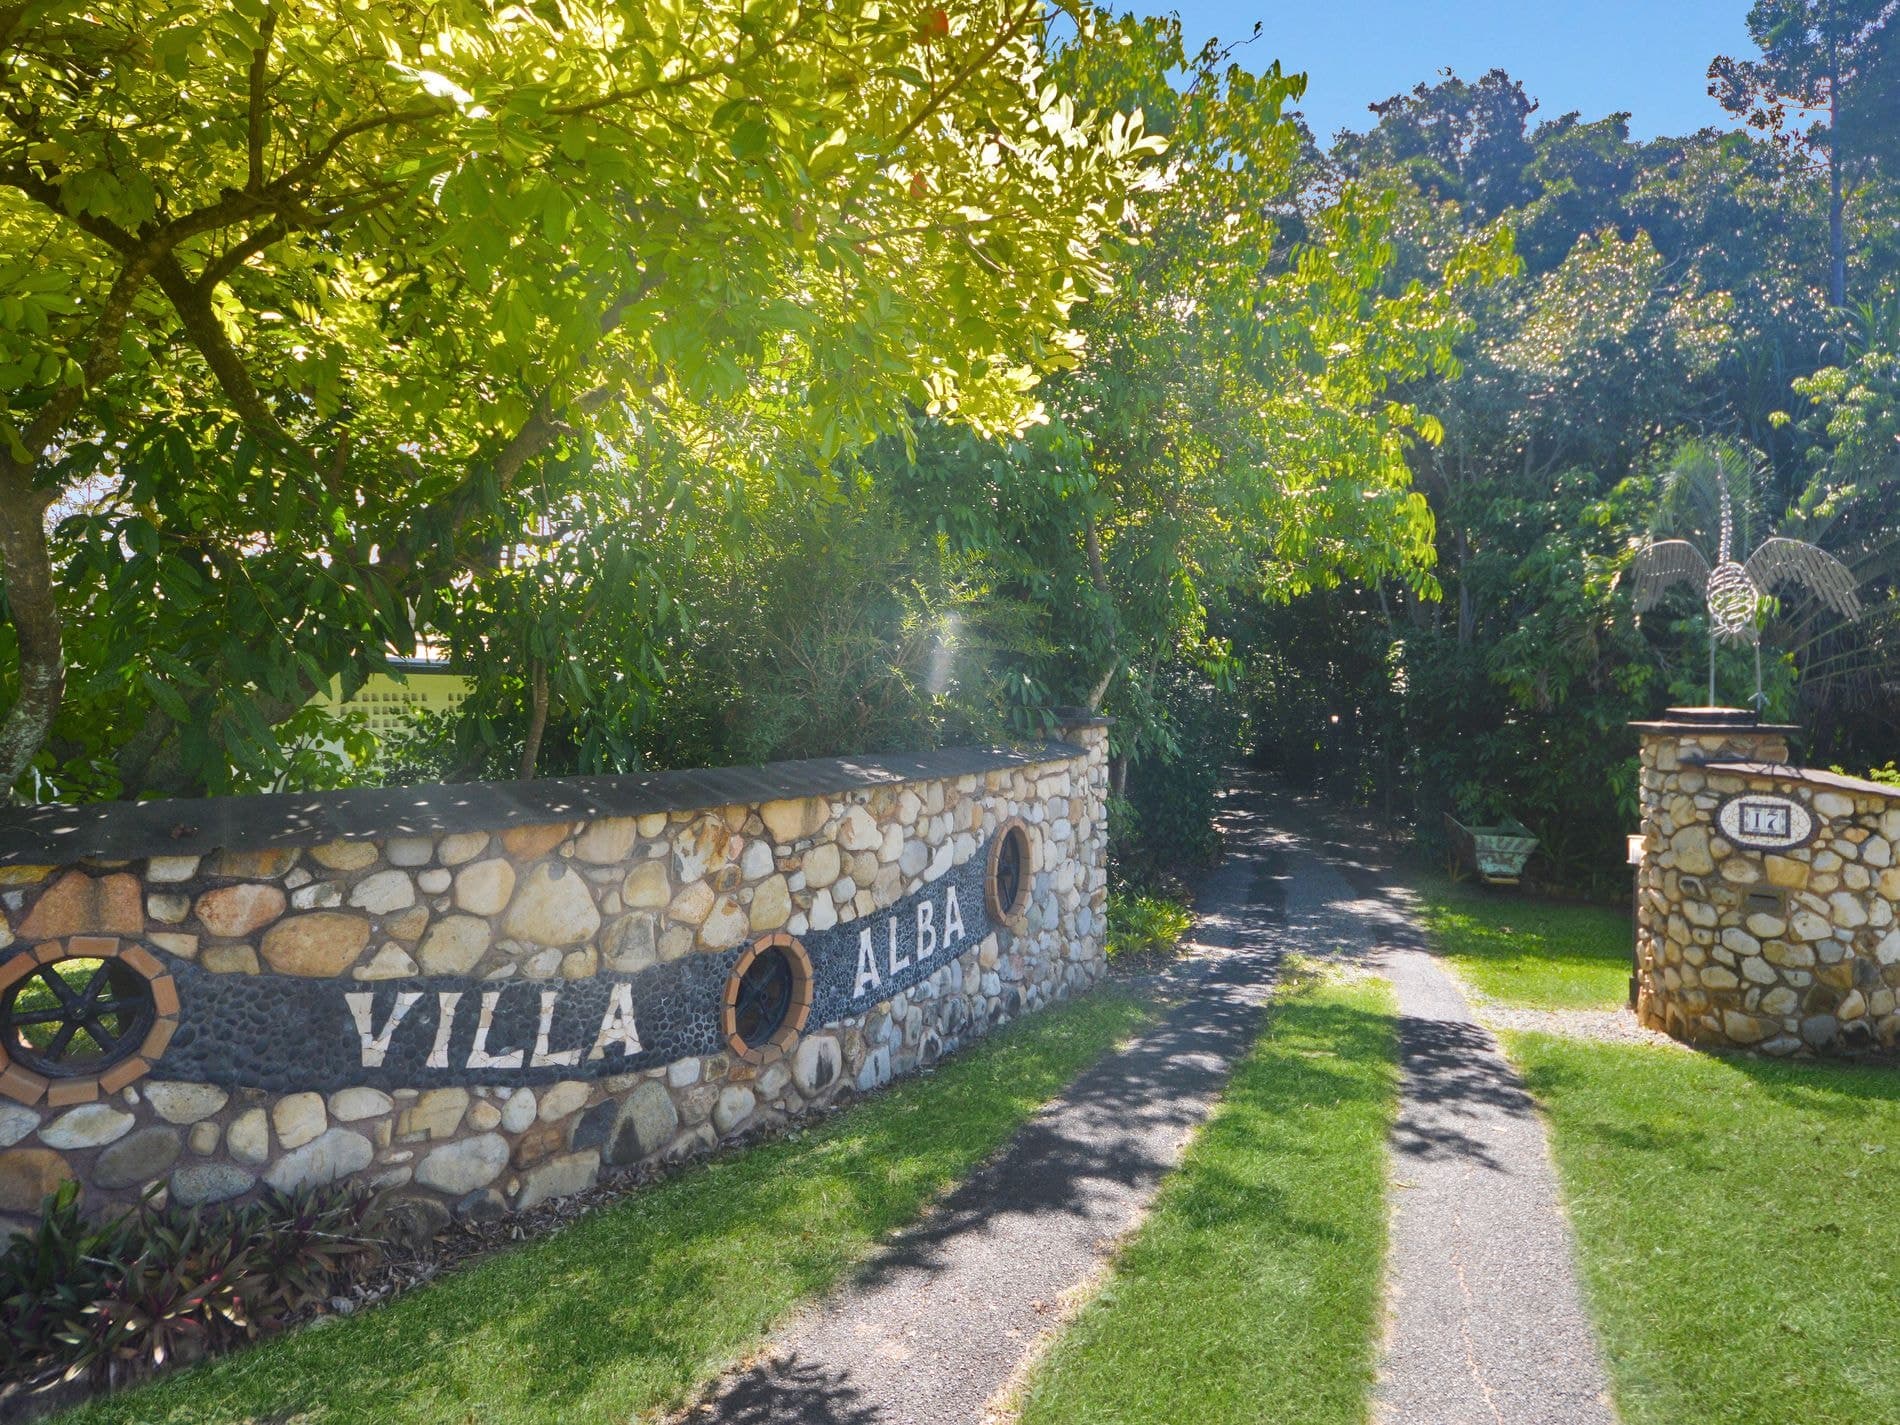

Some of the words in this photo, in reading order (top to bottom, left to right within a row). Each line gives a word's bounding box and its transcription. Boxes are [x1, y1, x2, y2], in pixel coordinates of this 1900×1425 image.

[1752, 812, 1779, 829] 17
[344, 983, 643, 1068] VILLA
[853, 885, 966, 999] ALBA
